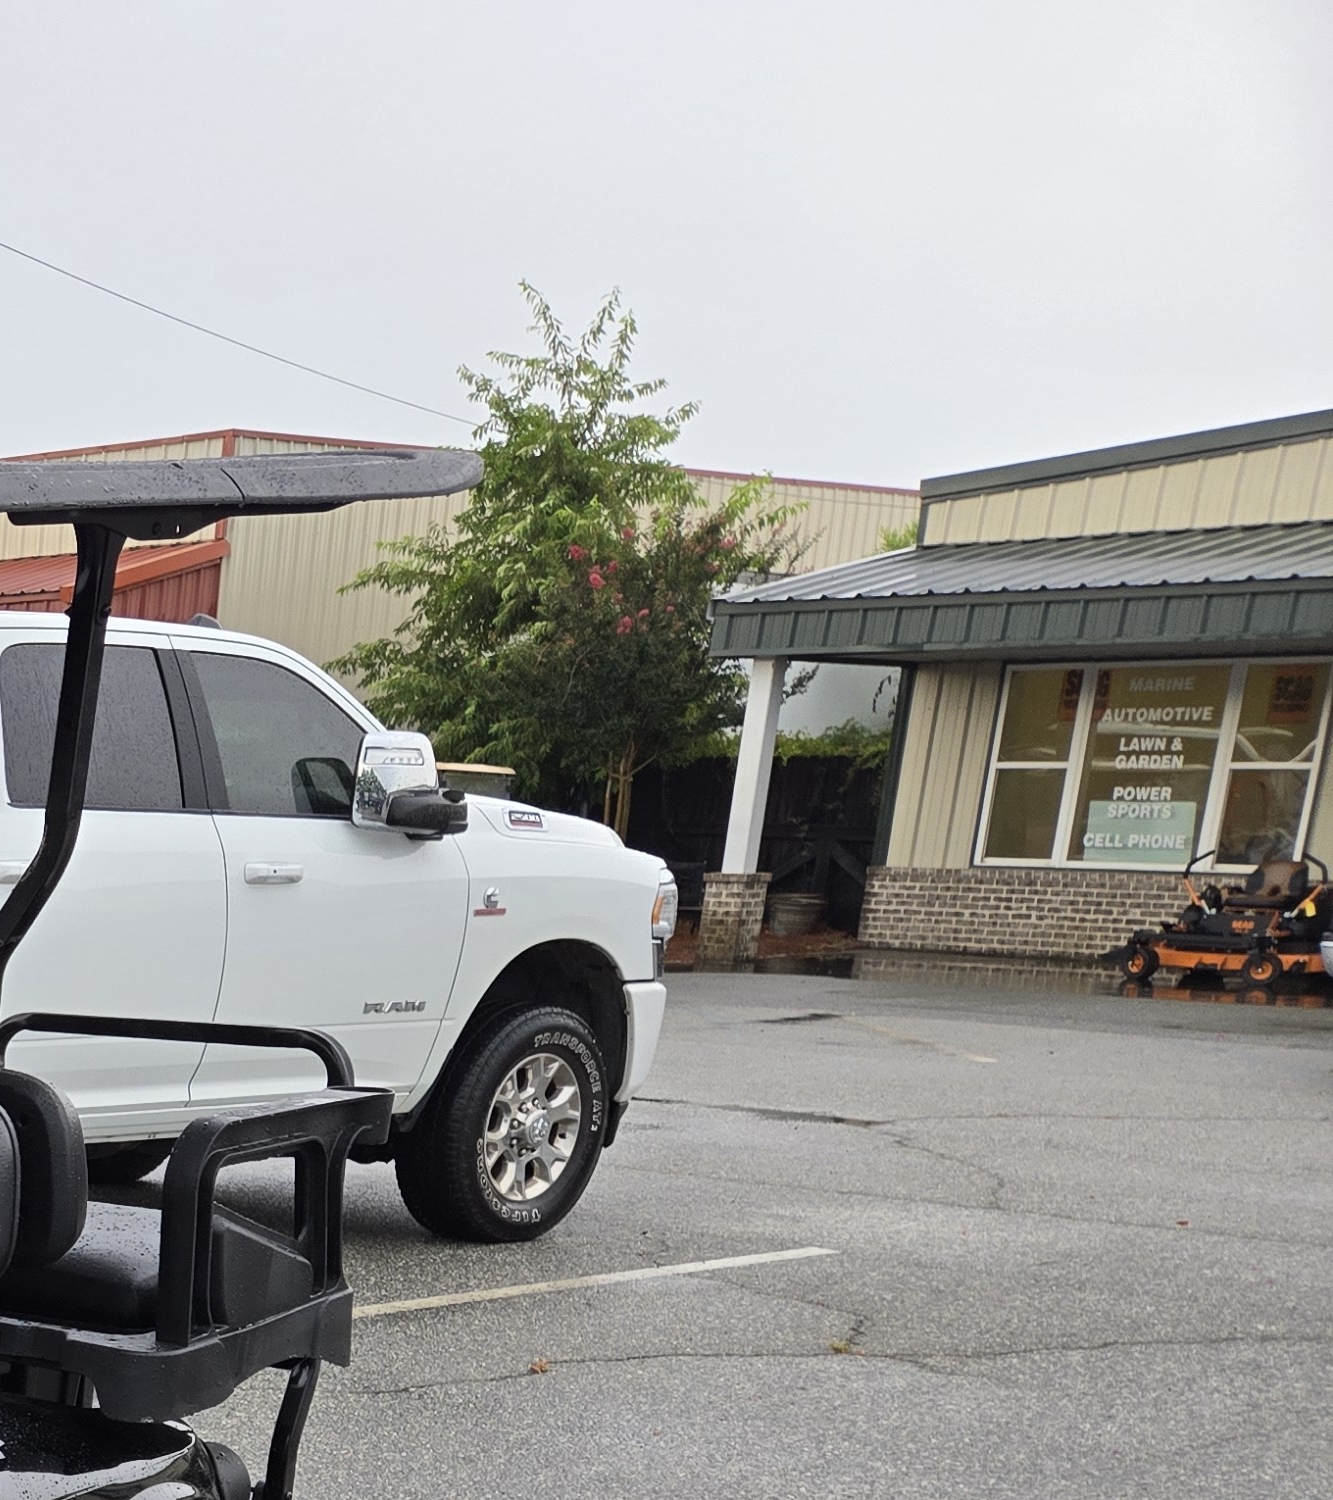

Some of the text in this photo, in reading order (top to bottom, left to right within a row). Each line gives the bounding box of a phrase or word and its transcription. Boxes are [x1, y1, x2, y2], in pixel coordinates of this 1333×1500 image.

[1129, 676, 1195, 692] MARINE
[1101, 706, 1214, 722] AUTOMOTIVE
[1119, 737, 1183, 751] LAWN &
[1115, 754, 1184, 769] GARDEN
[1113, 786, 1172, 800] POWER
[1107, 803, 1172, 819] SPORTS
[1083, 833, 1186, 849] CELL PHONE
[362, 1000, 426, 1015] RAM
[533, 1032, 602, 1094] TRANSFORCE
